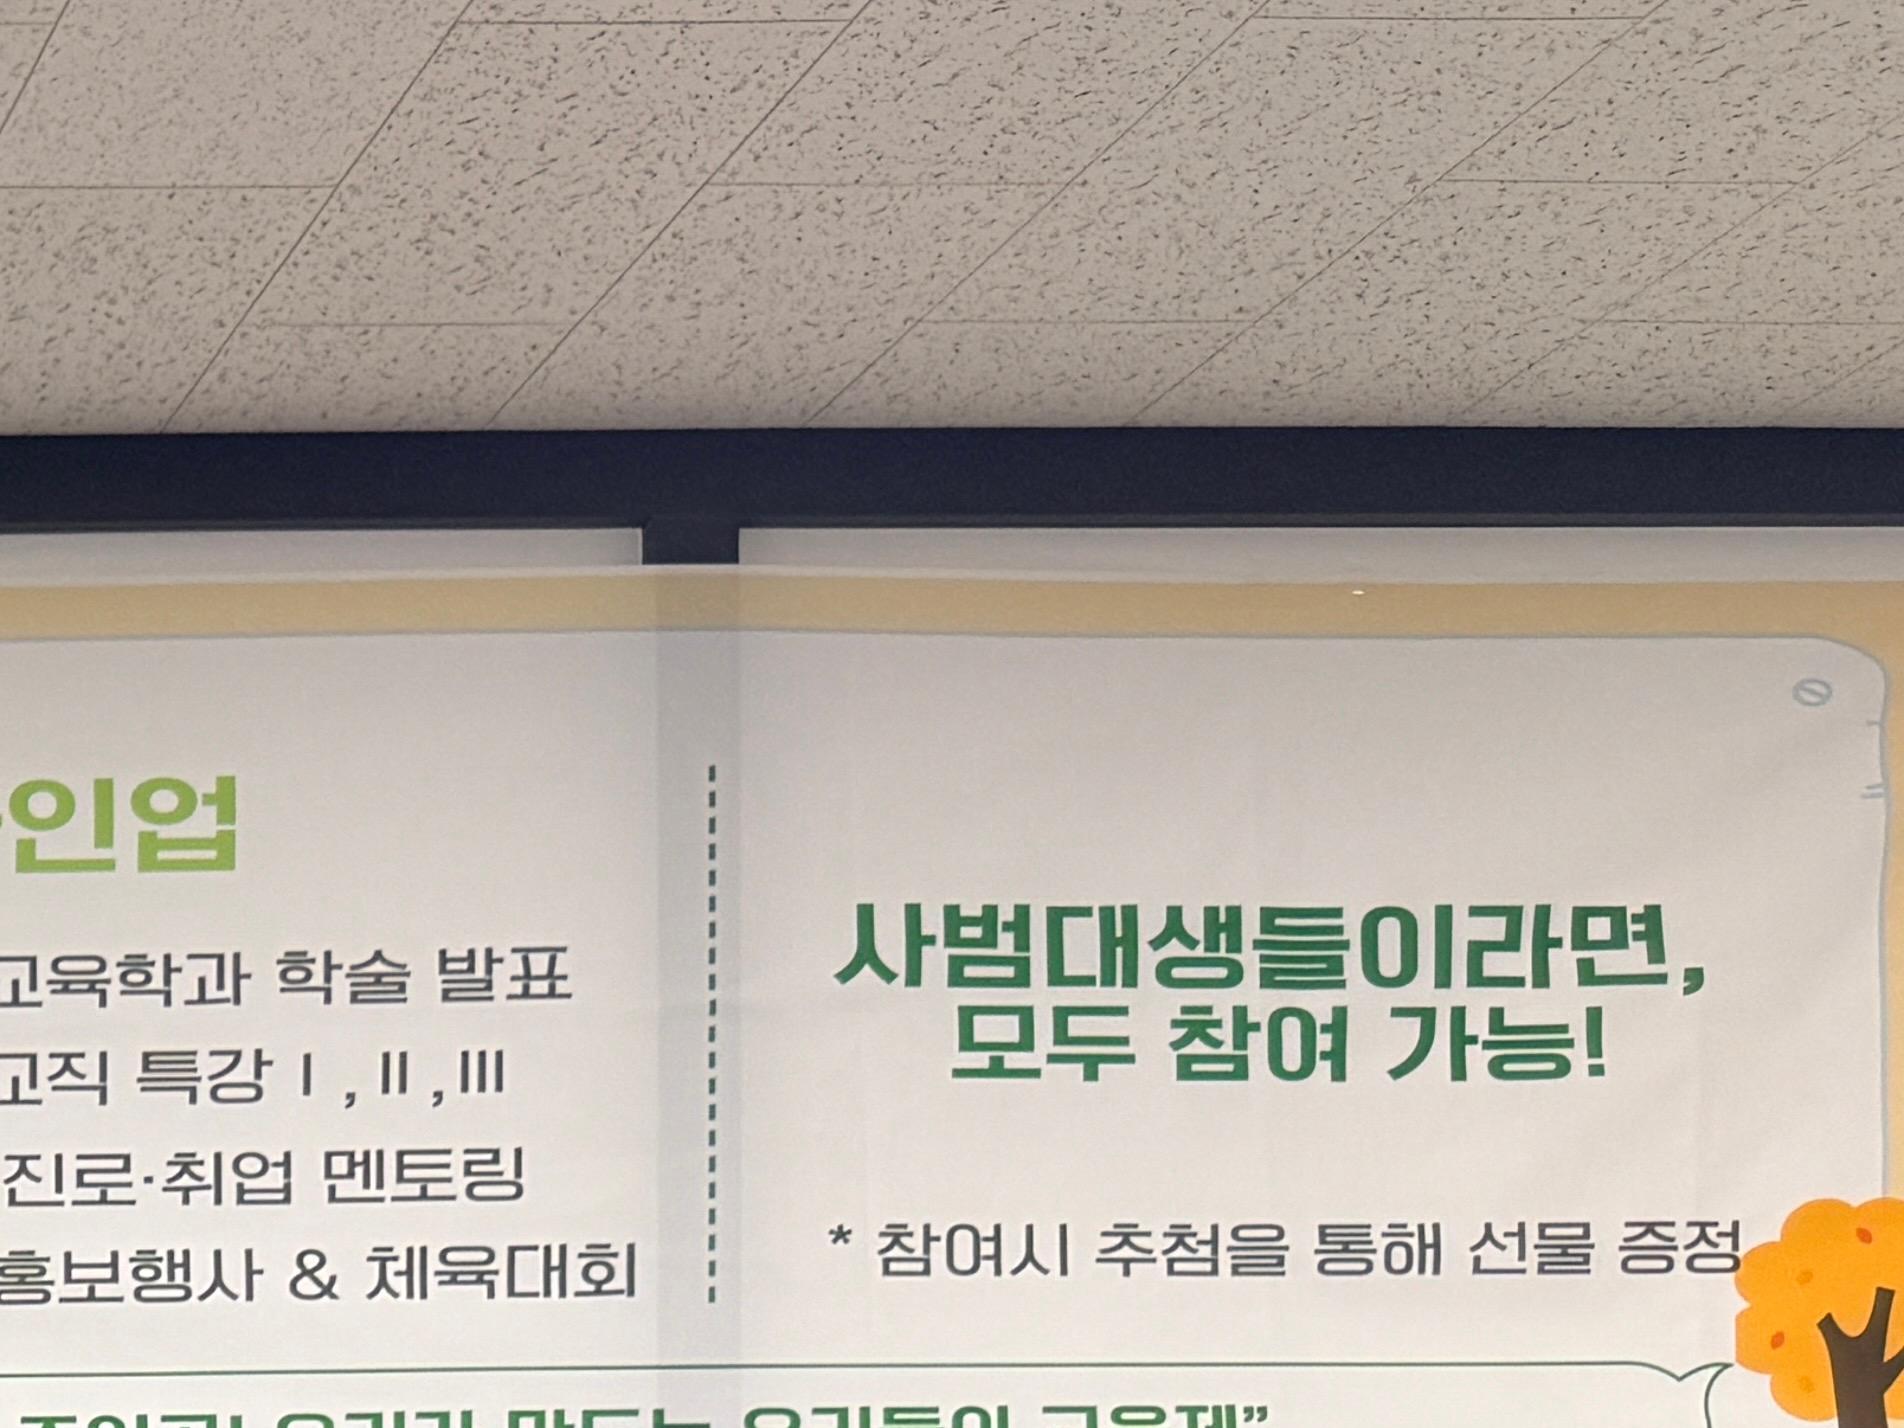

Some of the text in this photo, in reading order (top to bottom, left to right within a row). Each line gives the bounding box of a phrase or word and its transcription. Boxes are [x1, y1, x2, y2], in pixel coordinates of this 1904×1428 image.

[276, 946, 413, 1010] 학술
[435, 944, 576, 1007] 발표
[833, 902, 1707, 997] 사범대생들이라면,
[135, 1047, 275, 1107] 특강
[951, 1004, 1607, 1083] 모두 참여 가능!
[0, 1148, 296, 1213] 진로·취업
[322, 1145, 527, 1207] 멘토링
[288, 1253, 340, 1306] &
[366, 1238, 638, 1304] 체육대회
[876, 1221, 1072, 1281] 참여시
[1094, 1221, 1291, 1280] 추첨을
[1314, 1220, 1444, 1279] 통해
[1467, 1220, 1595, 1279] 선물
[1617, 1218, 1743, 1277] 증정
